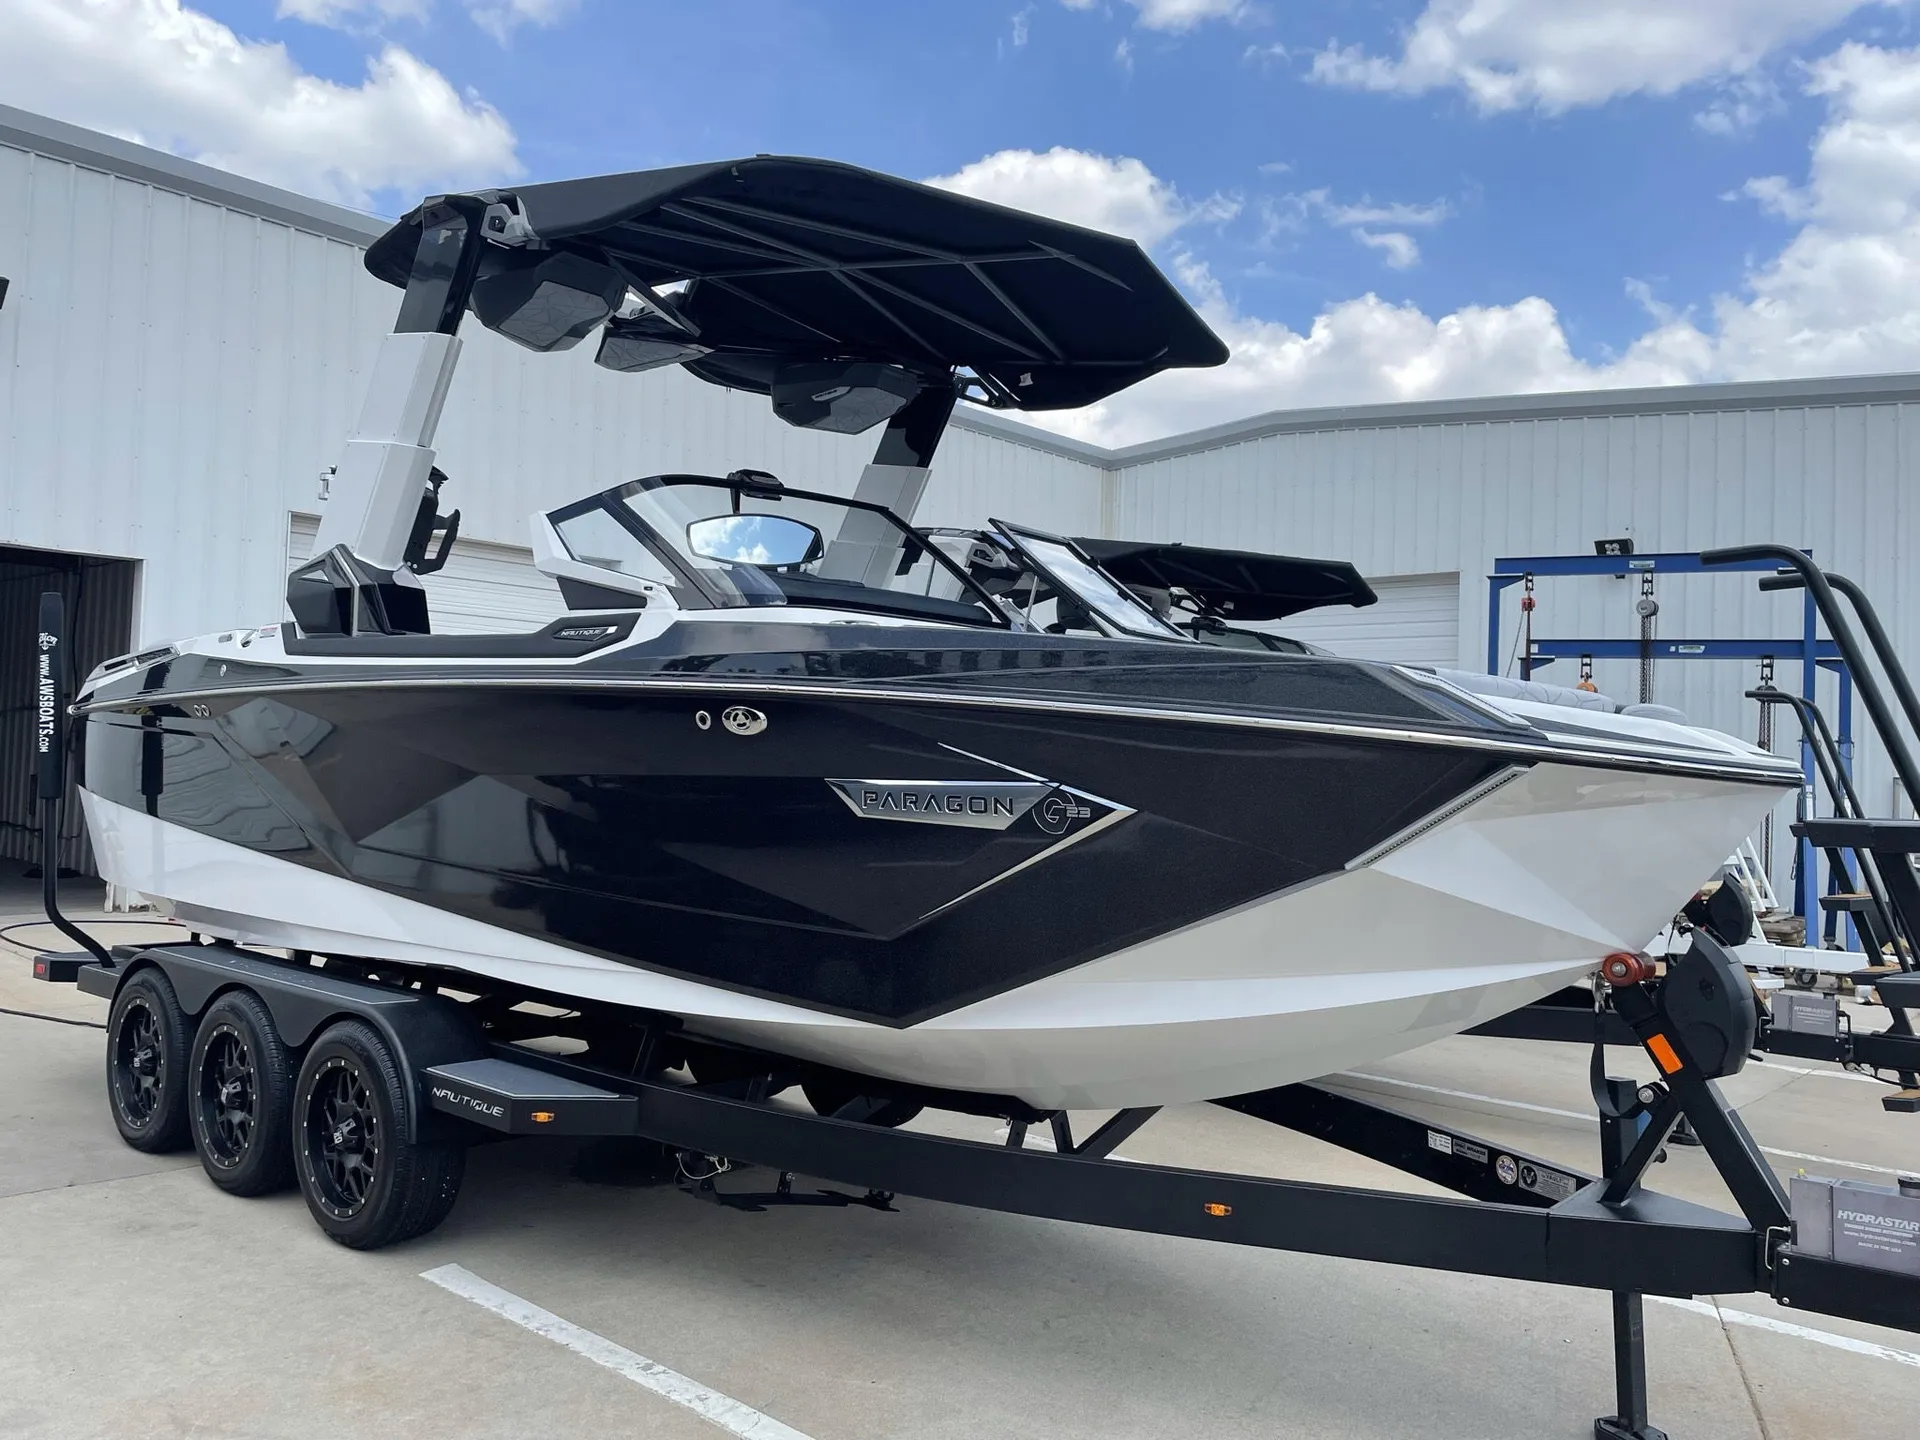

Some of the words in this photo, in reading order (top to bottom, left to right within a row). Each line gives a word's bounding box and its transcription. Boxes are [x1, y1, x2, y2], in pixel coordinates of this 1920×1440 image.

[861, 790, 1014, 817] PARAGON
[432, 1087, 504, 1117] NAUTIQUE
[1837, 1209, 1920, 1232] HYDRASTAR
